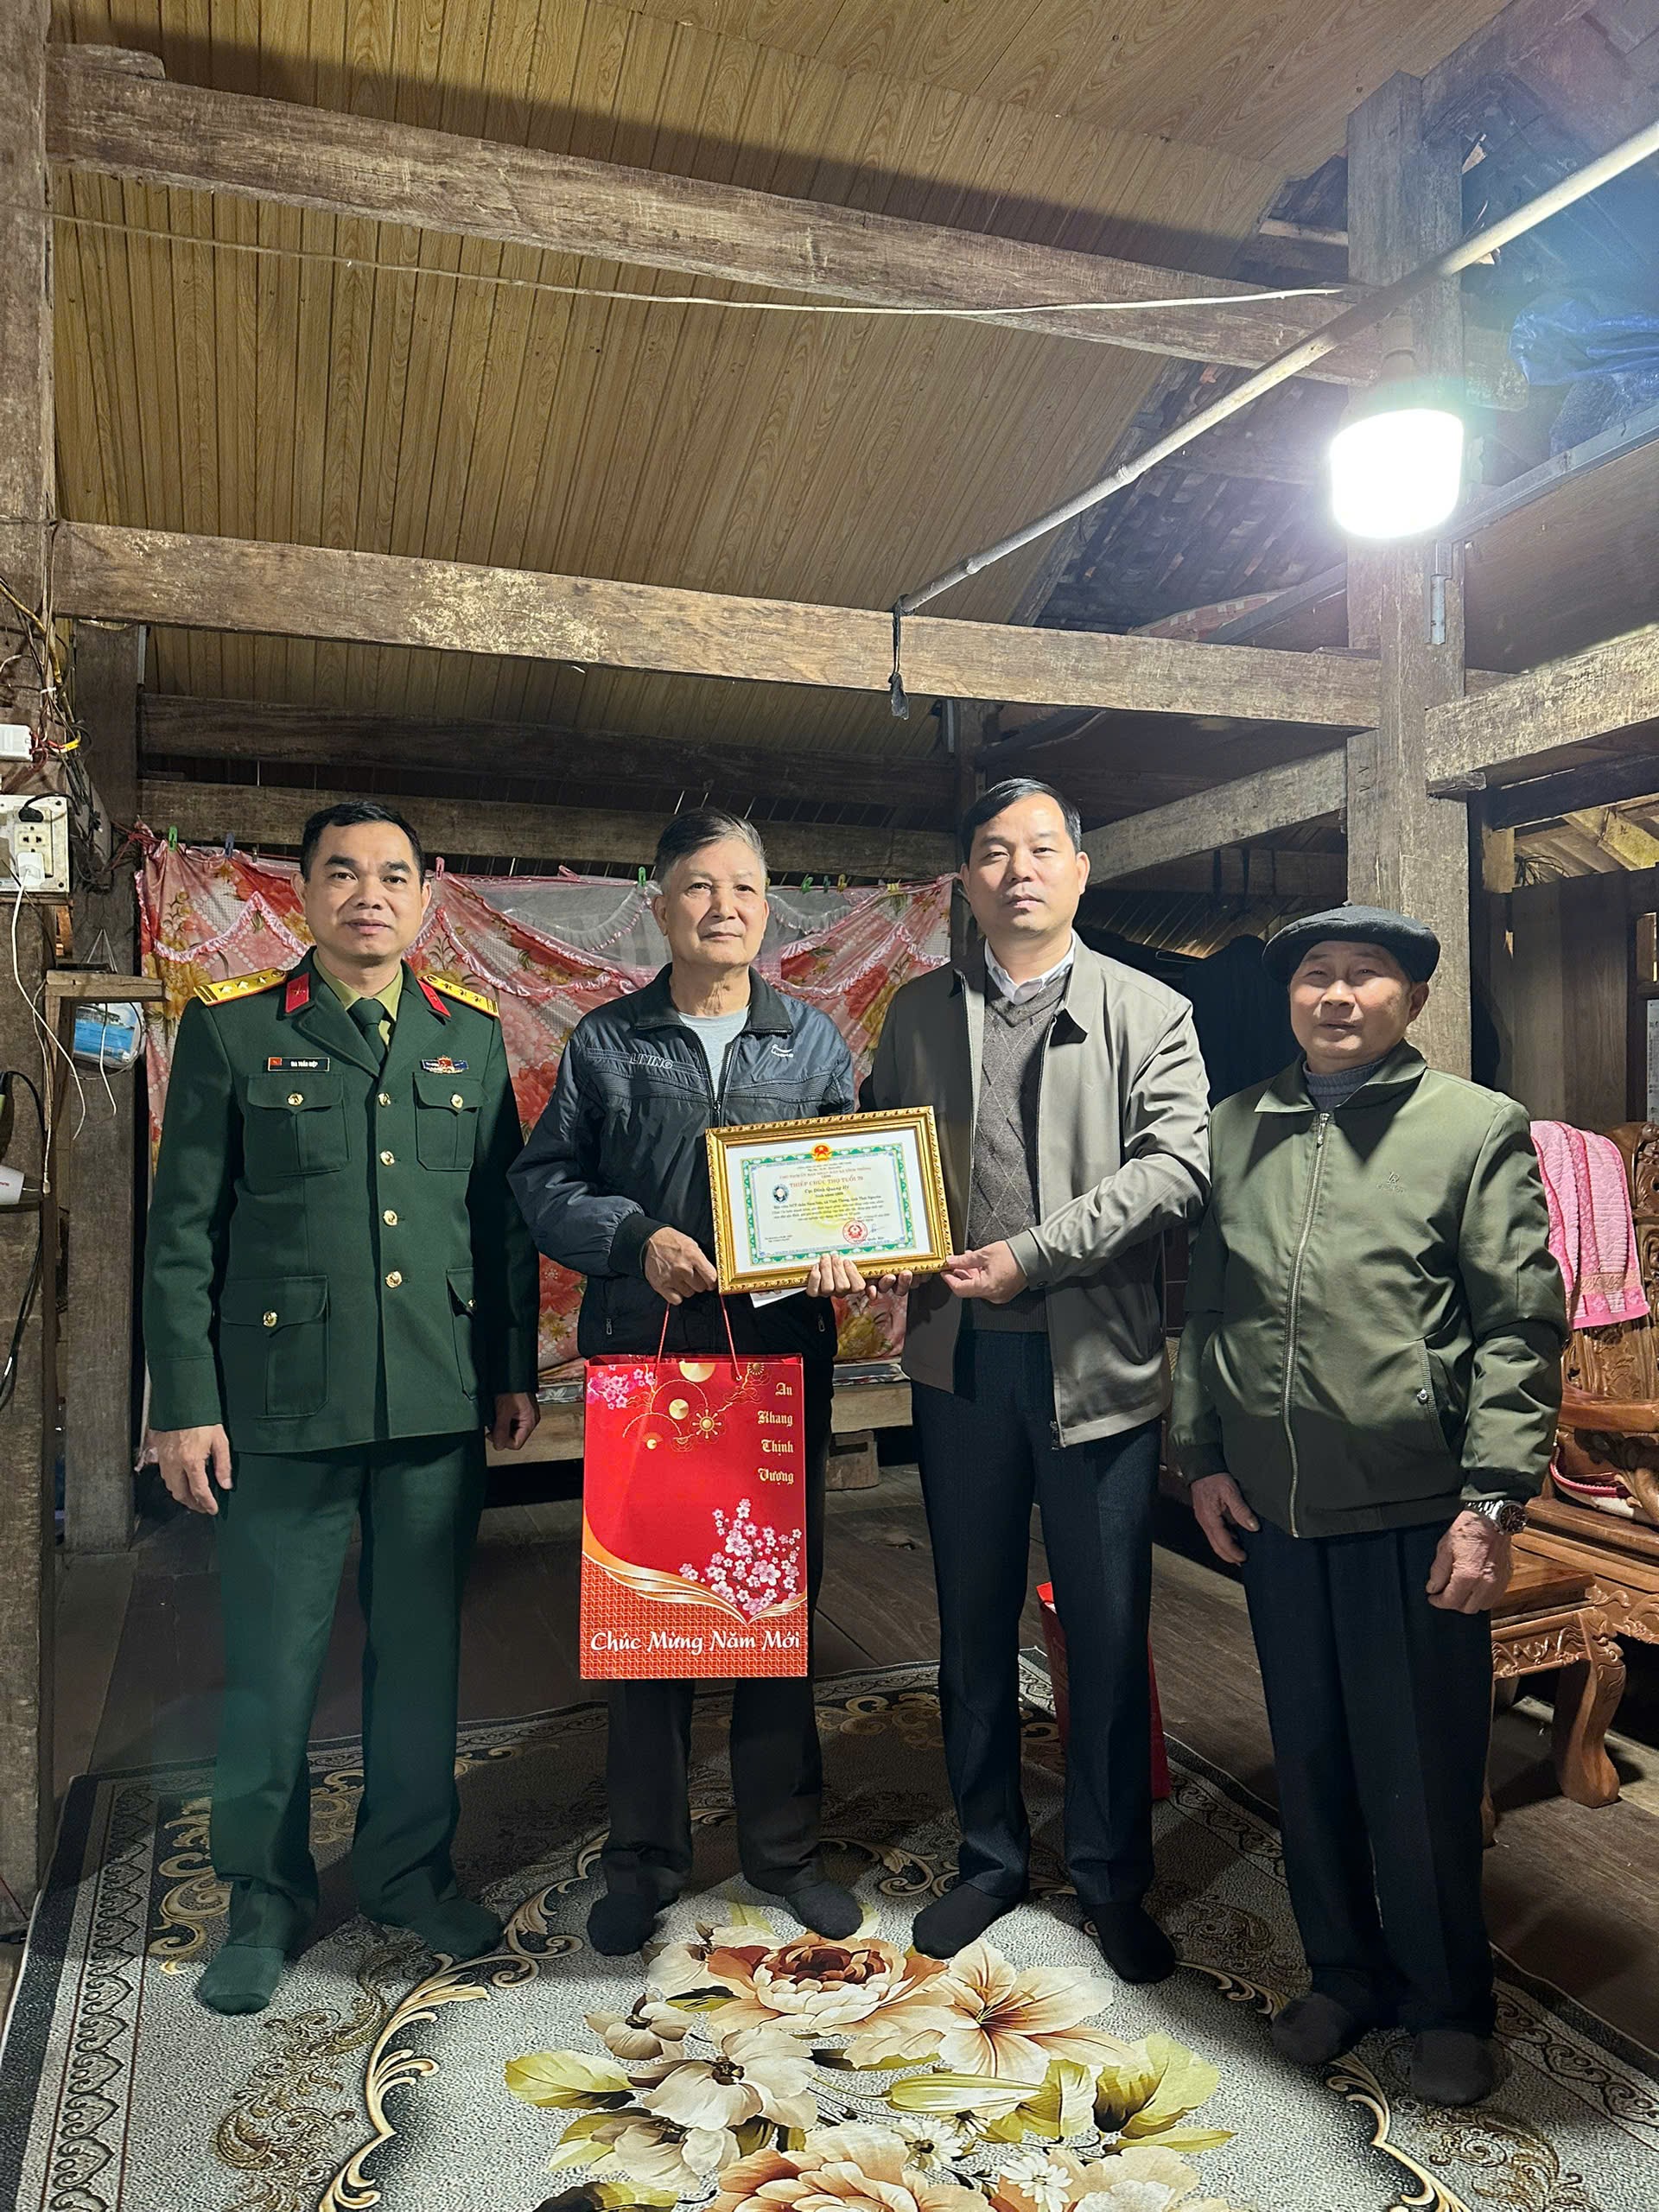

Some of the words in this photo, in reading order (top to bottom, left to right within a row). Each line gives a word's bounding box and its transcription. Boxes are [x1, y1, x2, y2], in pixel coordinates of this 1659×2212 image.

[841, 1174, 856, 1183] TUỔI
[775, 1382, 792, 1395] An
[758, 1410, 793, 1427] Khang
[761, 1439, 794, 1456] Thịnh
[758, 1468, 794, 1485] Vượng
[590, 1630, 642, 1652] Chúc
[646, 1630, 703, 1656] Mừng
[709, 1630, 756, 1651] Năm
[761, 1630, 799, 1651] Mới
